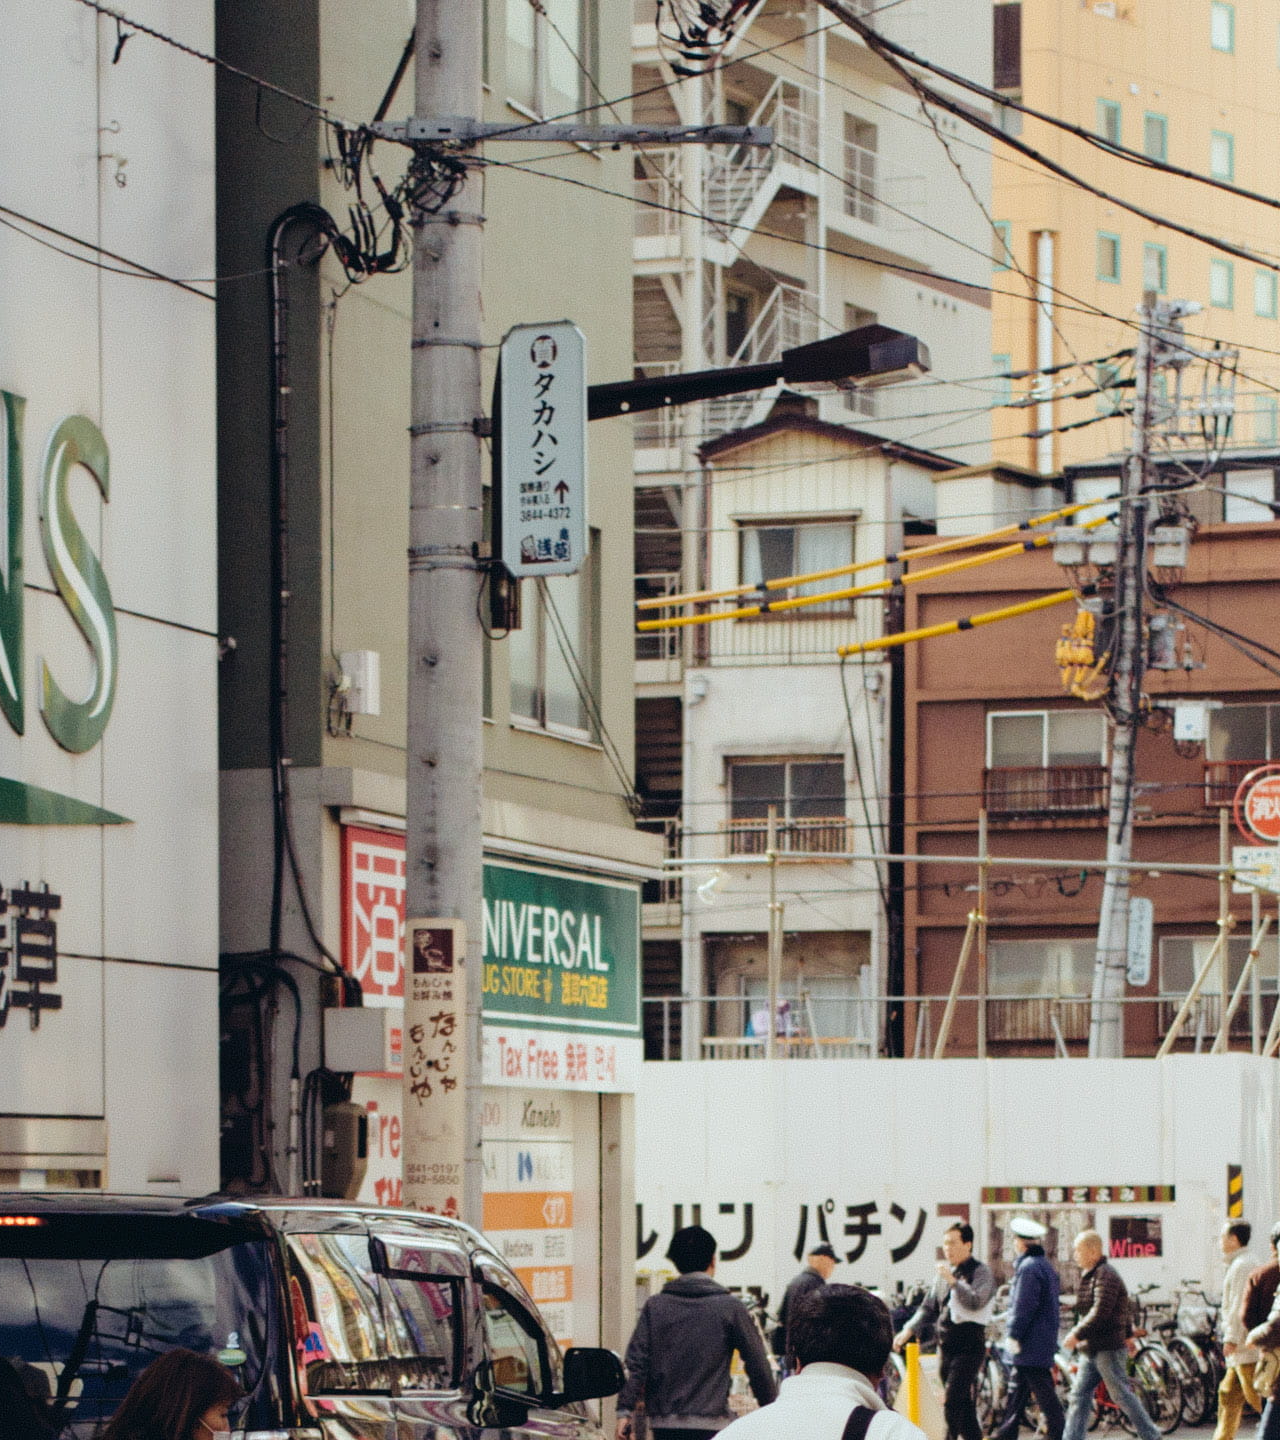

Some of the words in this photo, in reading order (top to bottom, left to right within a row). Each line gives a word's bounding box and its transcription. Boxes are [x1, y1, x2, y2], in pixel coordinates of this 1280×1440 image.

[531, 373, 558, 476] タカハシ
[482, 898, 609, 972] NIVERSAL
[481, 963, 500, 994] UG
[502, 966, 541, 999] STORE
[497, 1036, 523, 1078] Tax
[527, 1039, 559, 1080] Free
[1110, 1239, 1157, 1258] Wine
